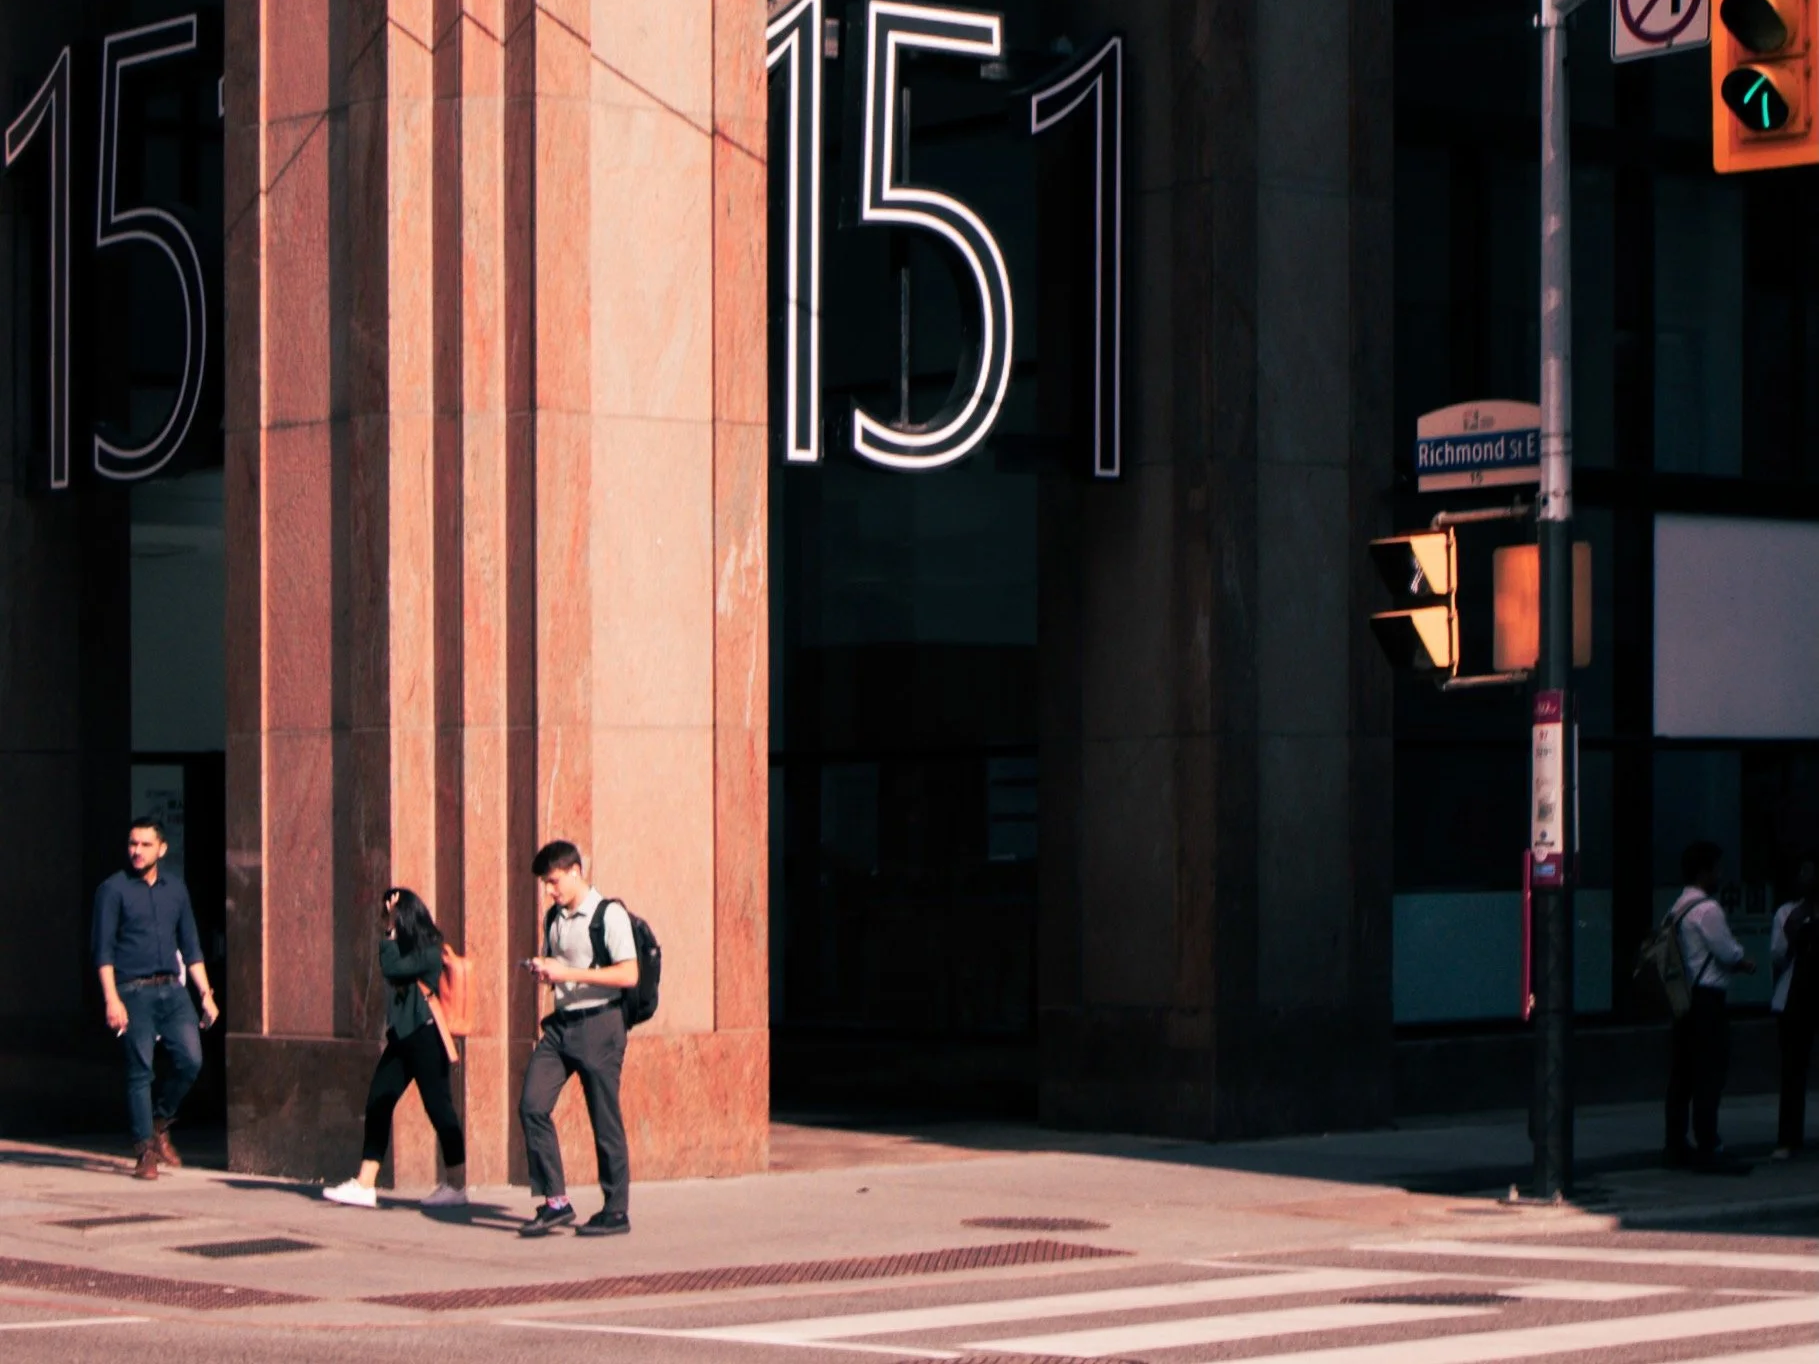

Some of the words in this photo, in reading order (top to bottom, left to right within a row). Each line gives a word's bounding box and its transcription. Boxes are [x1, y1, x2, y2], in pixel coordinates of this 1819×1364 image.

[5, 14, 225, 489] 15
[1418, 434, 1505, 468] Richmond
[1509, 440, 1523, 460] St
[1526, 431, 1536, 458] E
